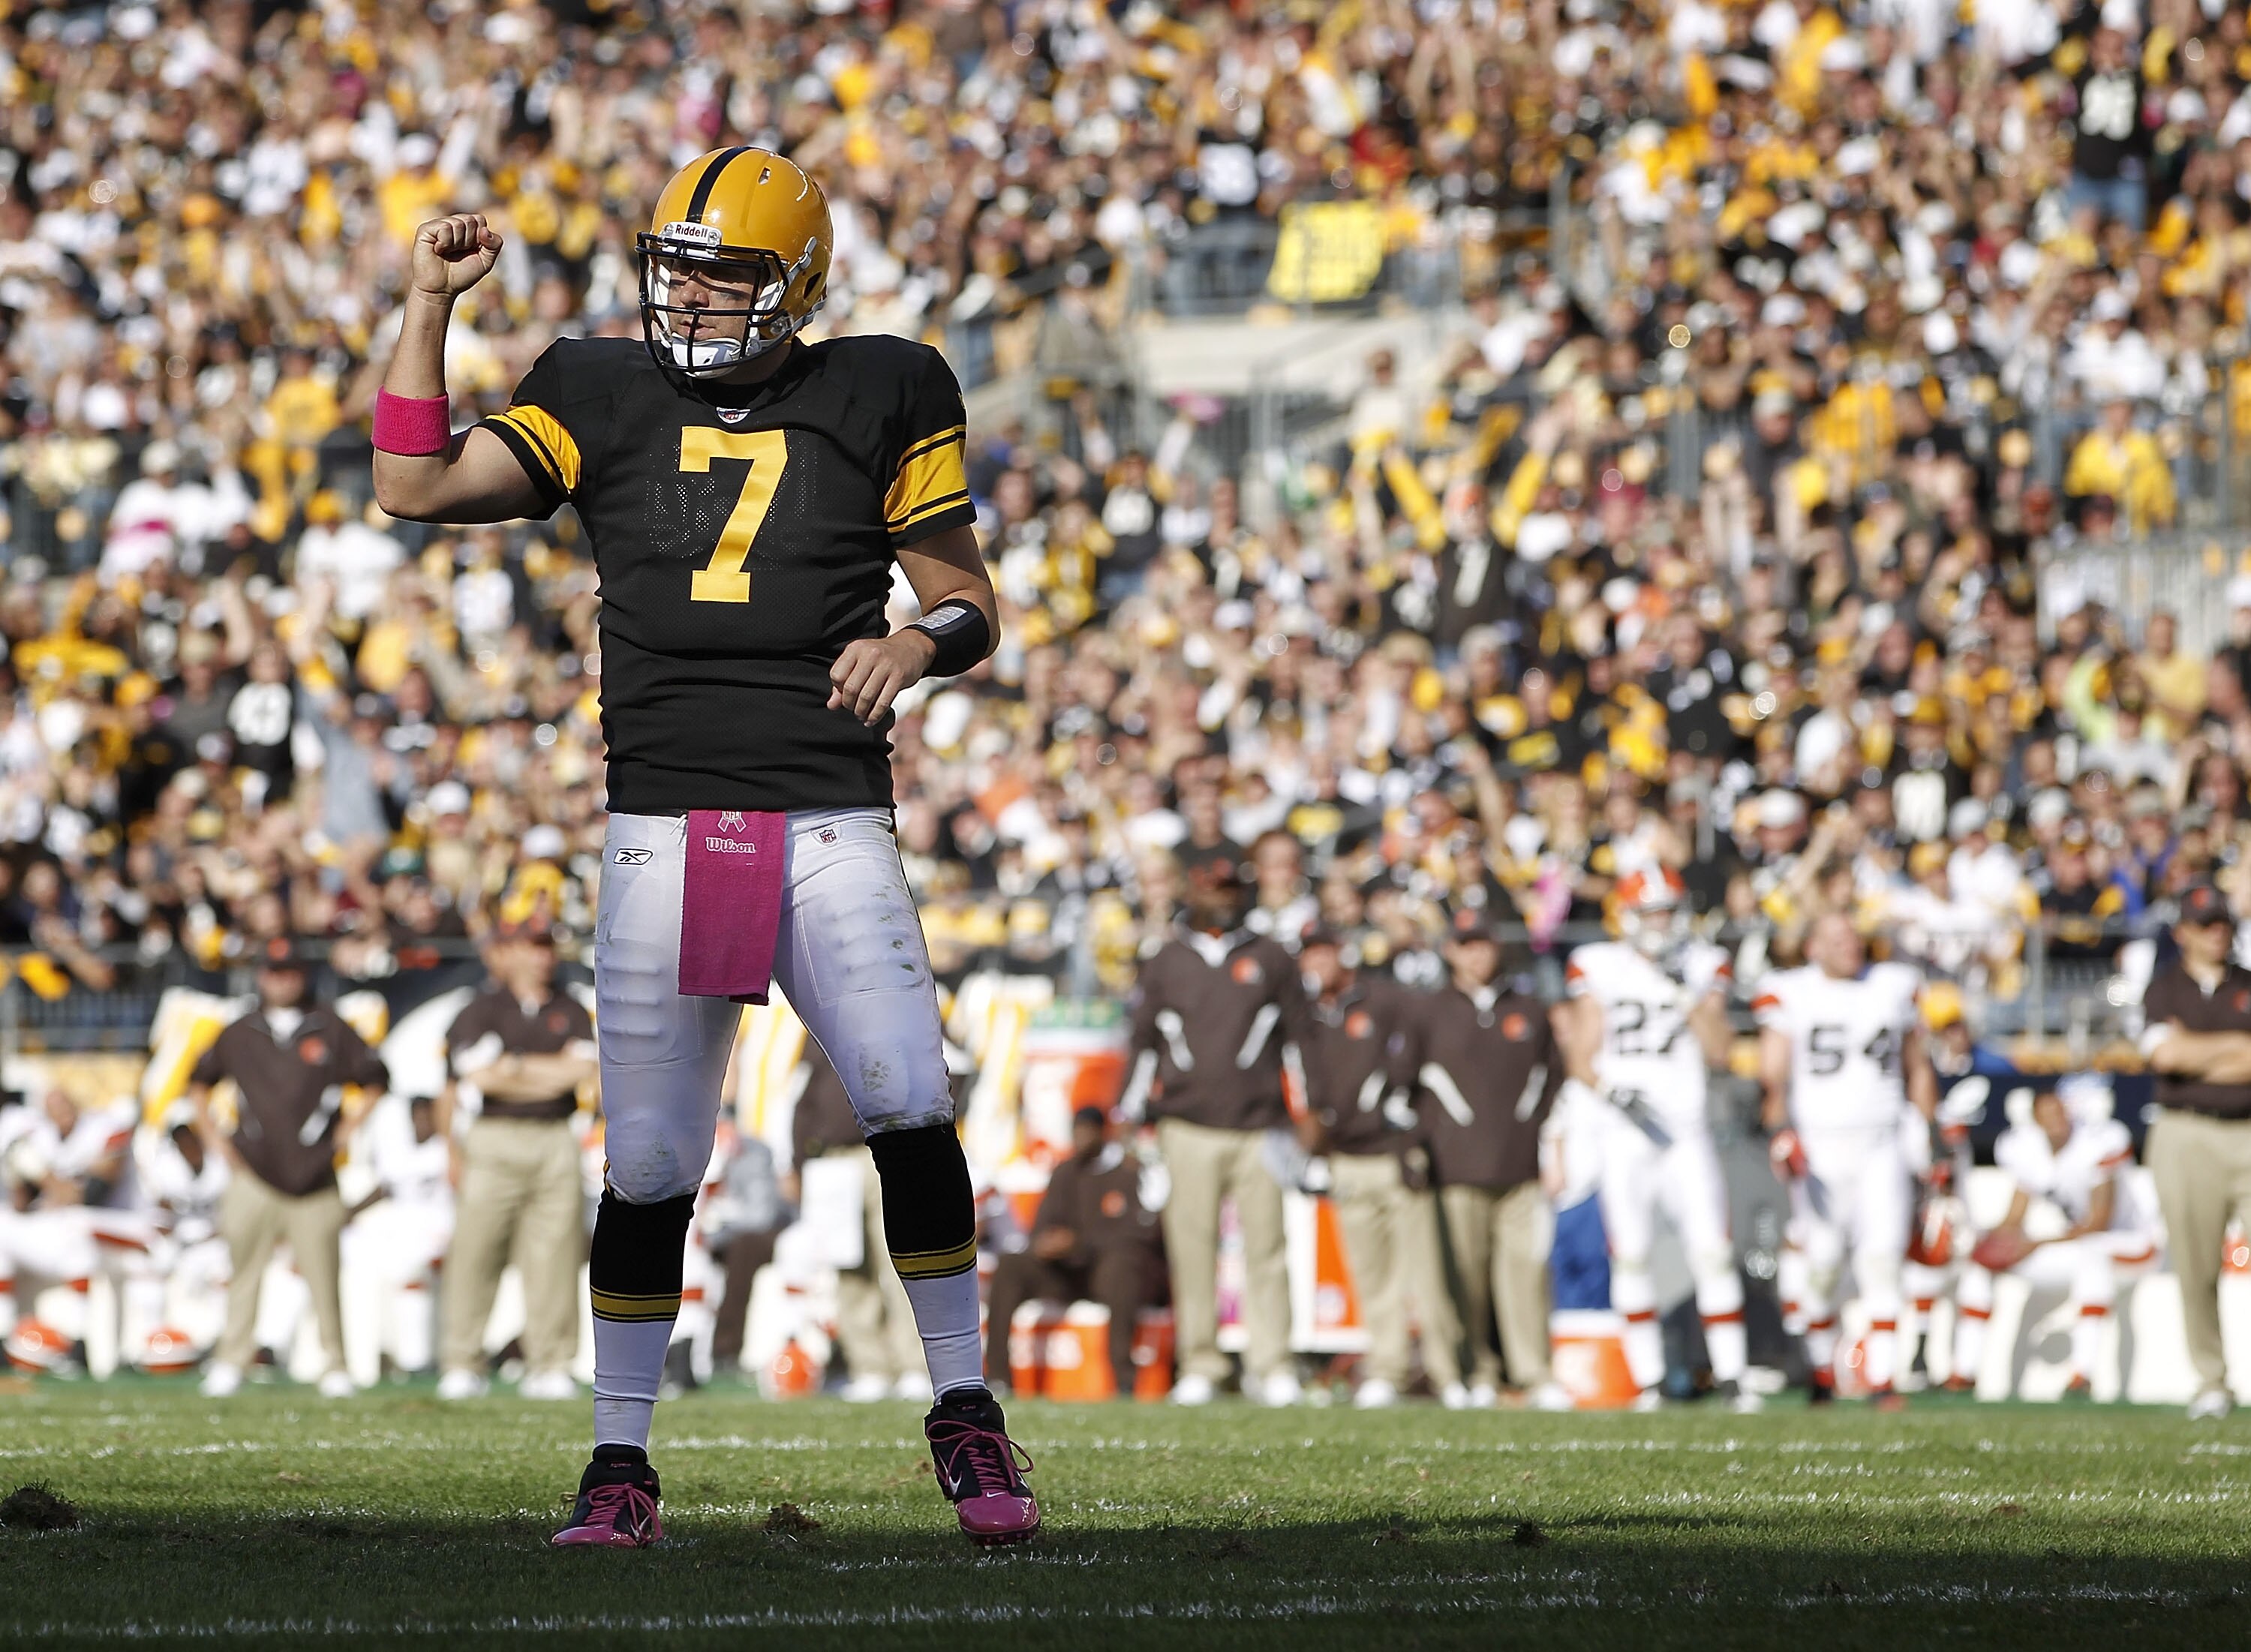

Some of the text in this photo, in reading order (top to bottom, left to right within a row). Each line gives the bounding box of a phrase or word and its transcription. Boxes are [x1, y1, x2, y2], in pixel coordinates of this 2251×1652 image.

[675, 224, 709, 238] Riddell
[678, 425, 789, 603] 7
[705, 837, 756, 854] Wilson
[1613, 999, 1691, 1056] 27
[1808, 1021, 1897, 1076] 54
